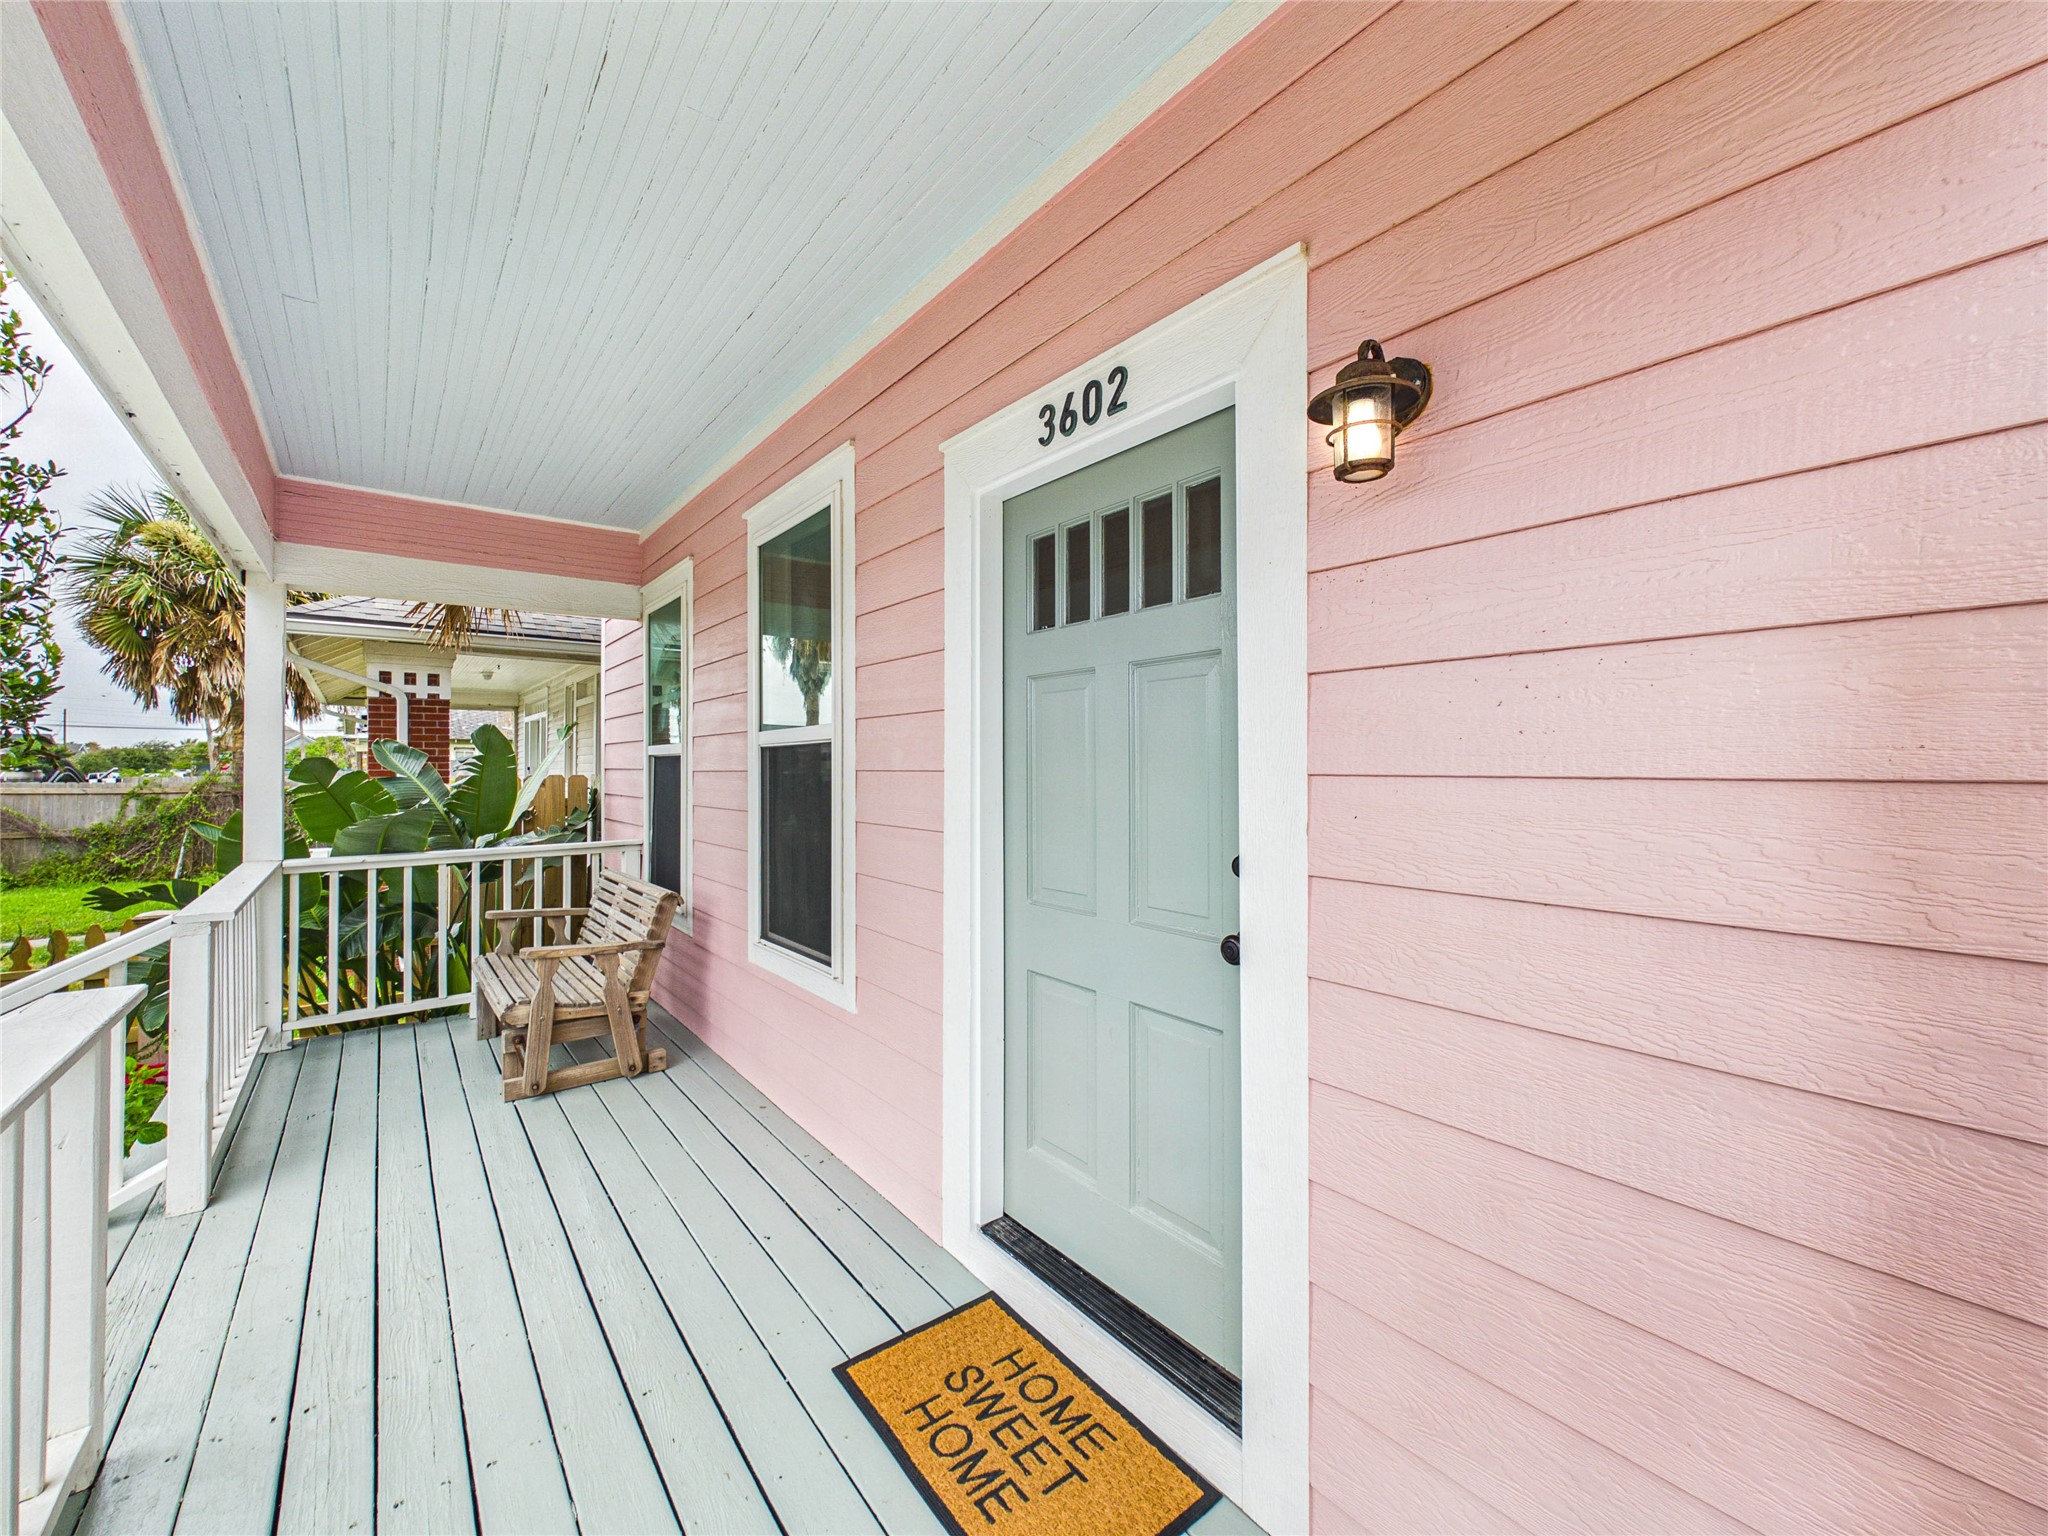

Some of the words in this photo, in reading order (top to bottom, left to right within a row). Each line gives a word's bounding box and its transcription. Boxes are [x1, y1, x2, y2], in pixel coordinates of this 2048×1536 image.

[1038, 366, 1128, 447] 3602
[904, 1394, 1029, 1525] HOME
[944, 1365, 1088, 1495] SWEET
[991, 1349, 1117, 1460] HOME
